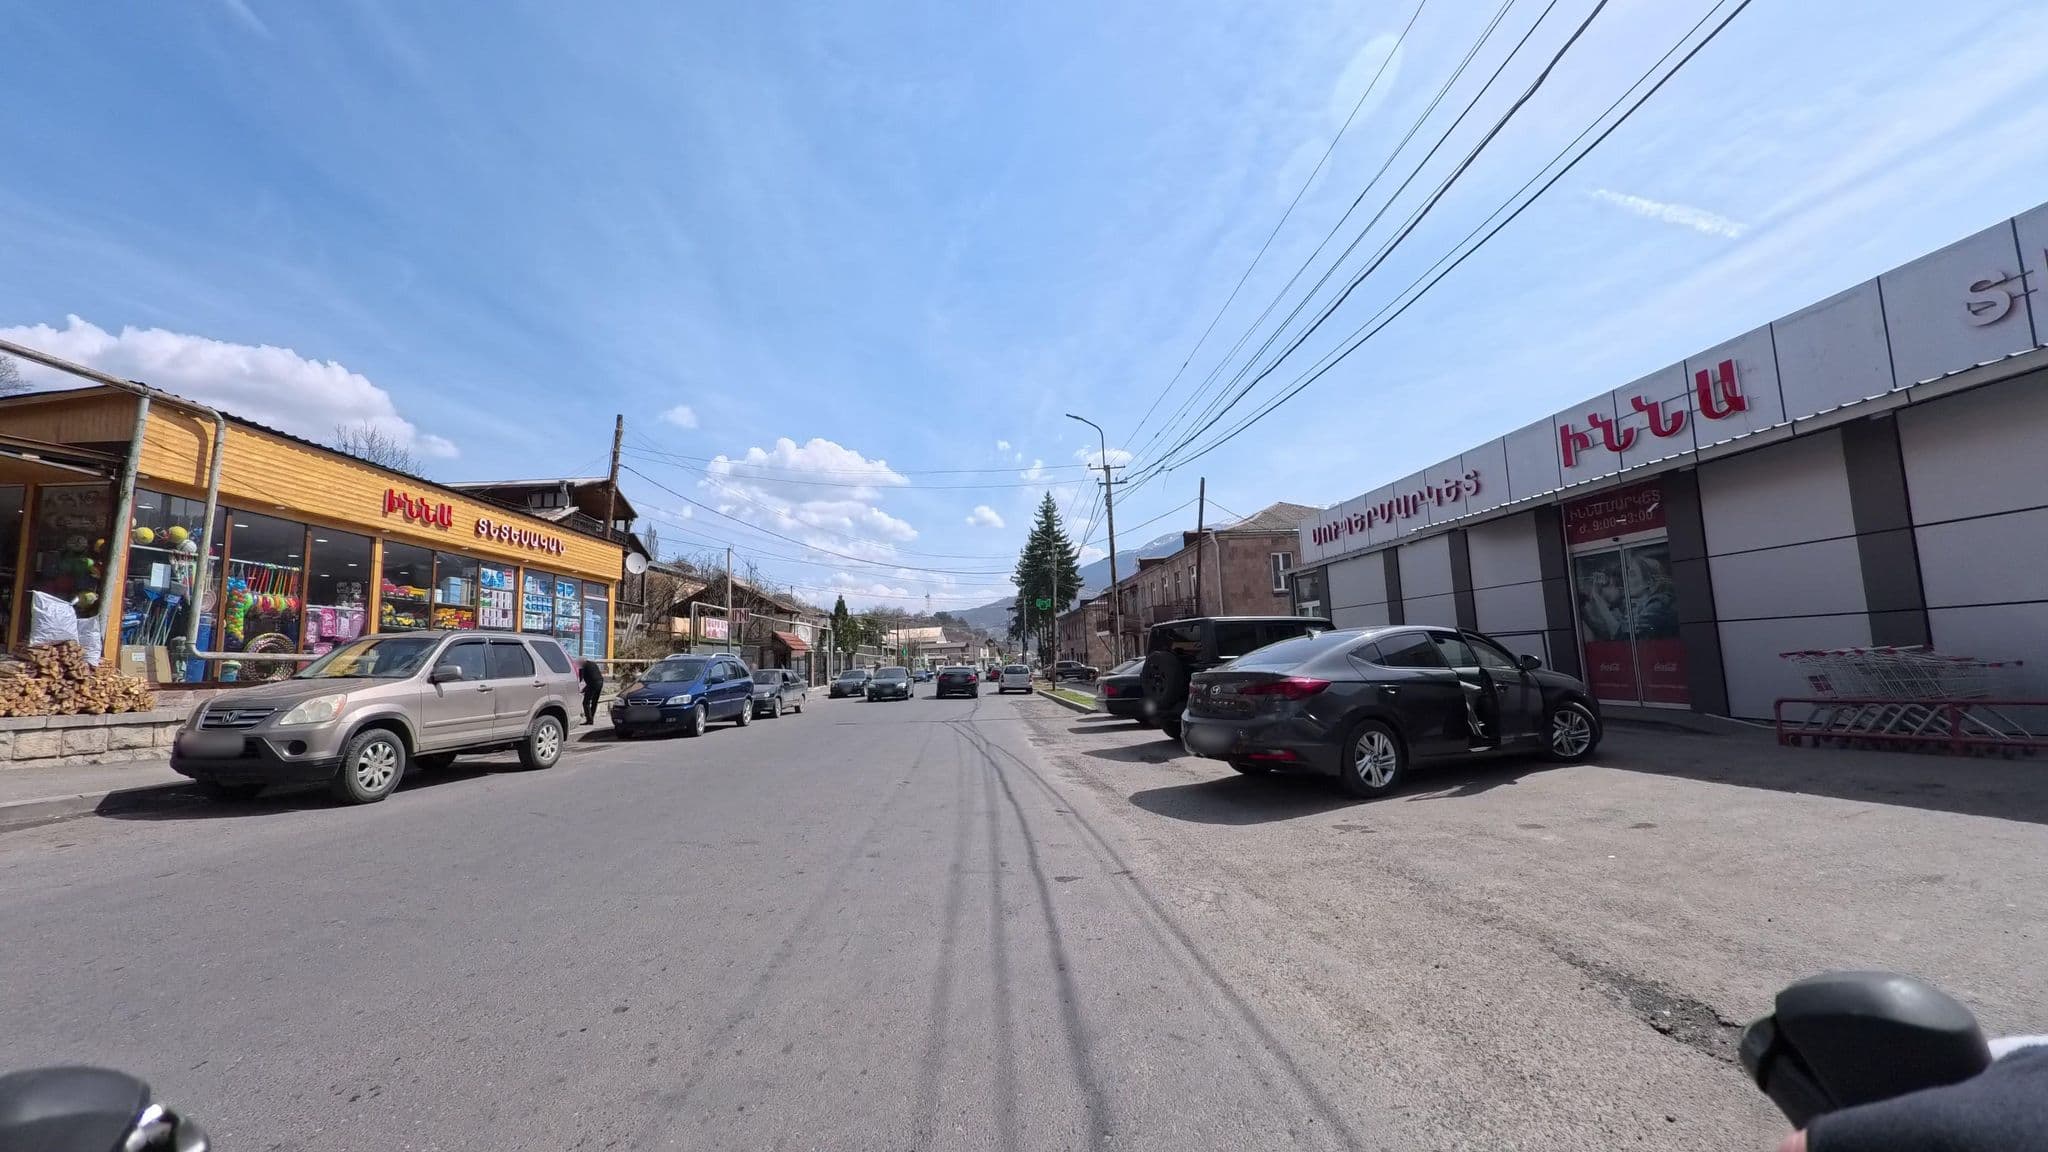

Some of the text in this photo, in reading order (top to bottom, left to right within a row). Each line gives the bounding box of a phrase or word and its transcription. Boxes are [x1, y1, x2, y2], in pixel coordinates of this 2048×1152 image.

[1312, 469, 1481, 546] ՍՈՒՊԵՐՄԱՐԿԵՏ
[1560, 359, 1748, 468] ԻՆՆԱ
[384, 488, 566, 554] ԻՆՆԱ ՏՆՏԵՍԱԿԱՆ
